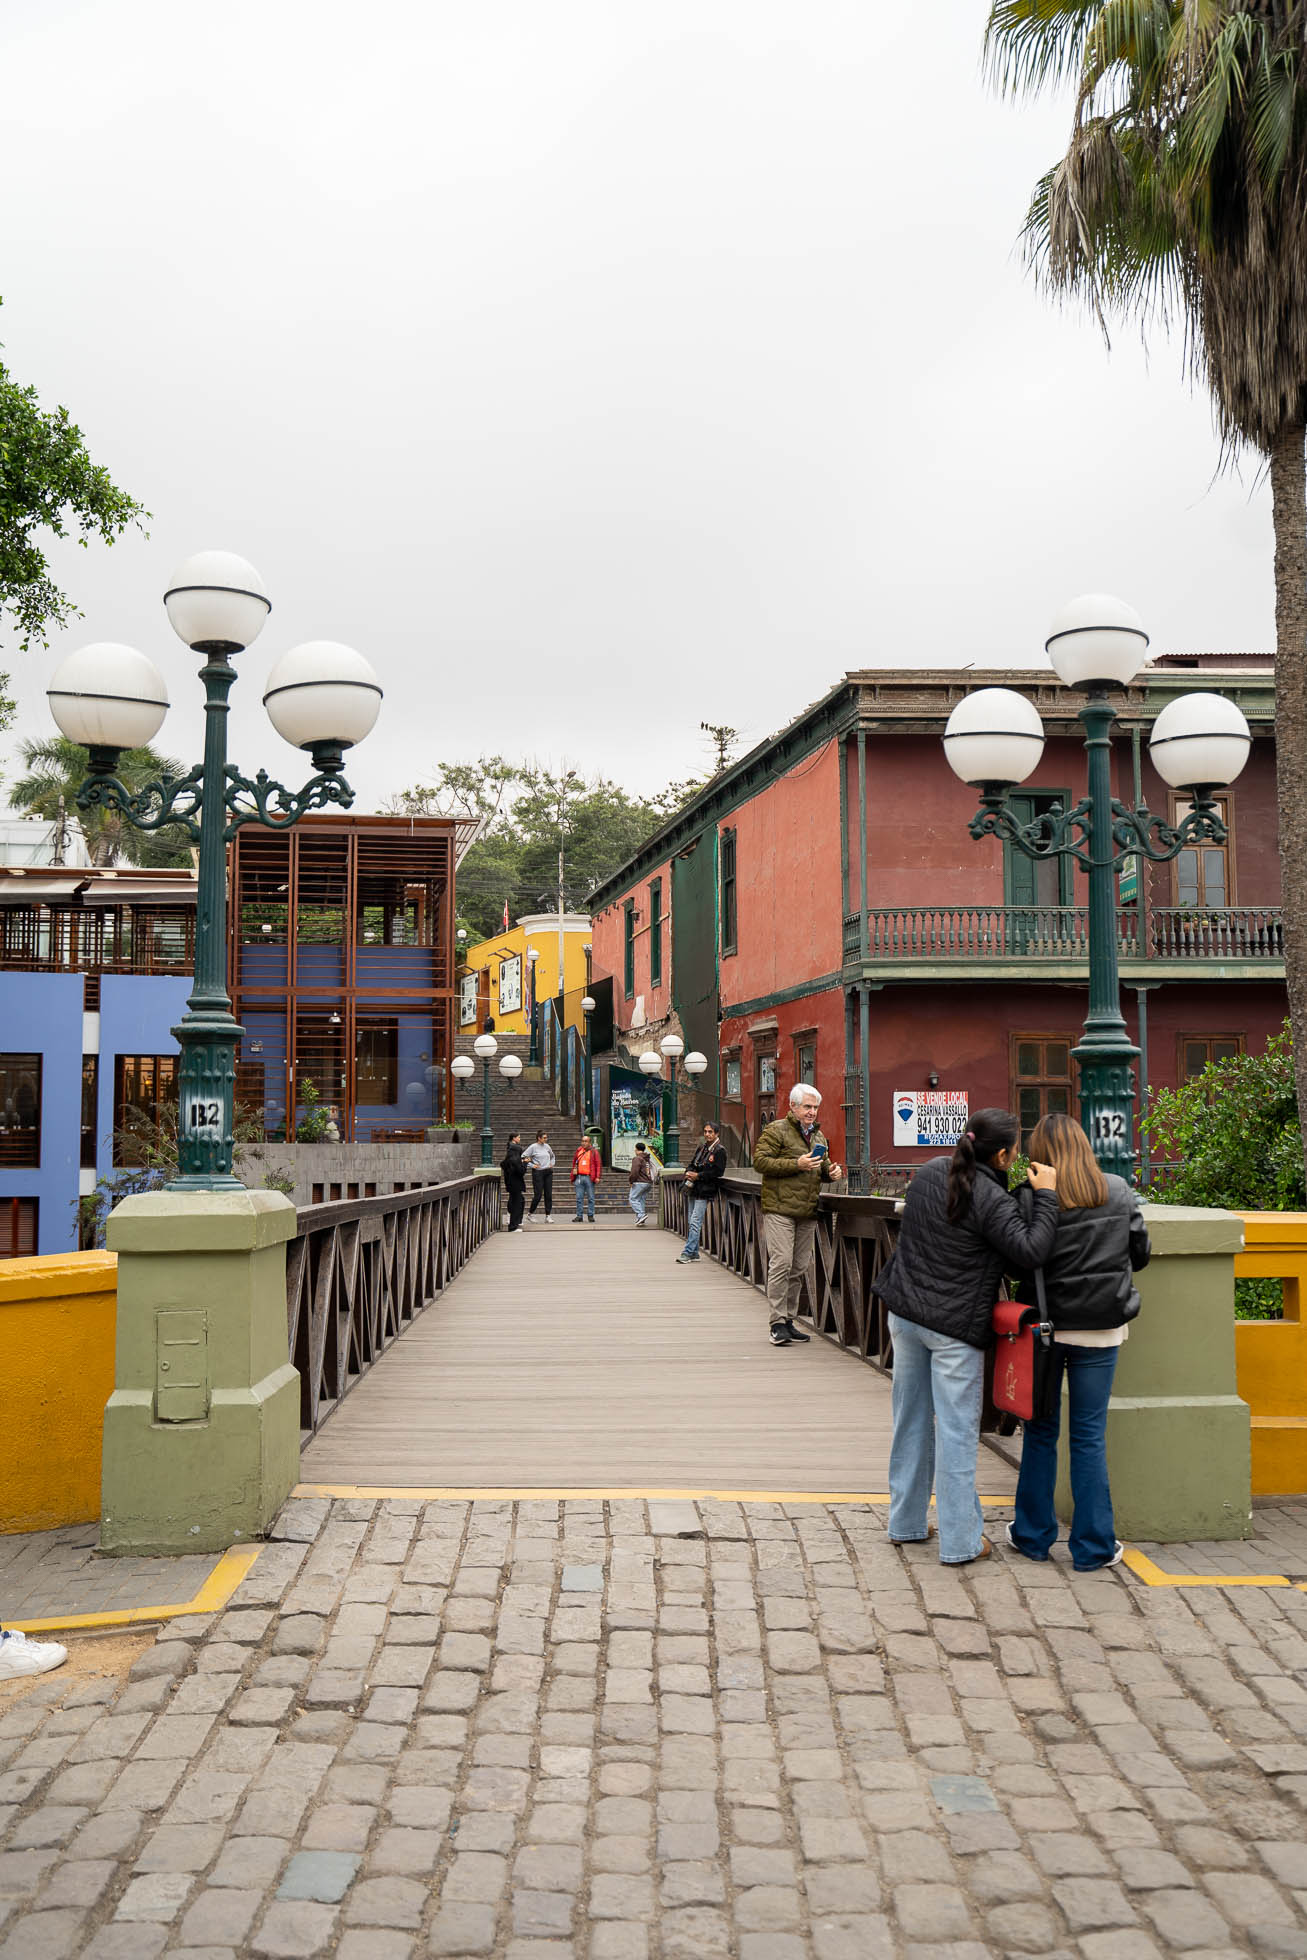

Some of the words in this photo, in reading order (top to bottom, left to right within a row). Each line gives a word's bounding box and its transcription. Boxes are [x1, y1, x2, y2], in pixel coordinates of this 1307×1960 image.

[917, 1092, 925, 1104] SE
[926, 1092, 946, 1104] VENDE
[948, 1092, 967, 1104] LOCAL
[917, 1106, 941, 1116] CESARINA
[943, 1106, 966, 1116] VASSALLO
[918, 1118, 932, 1134] 941
[935, 1118, 950, 1134] 930
